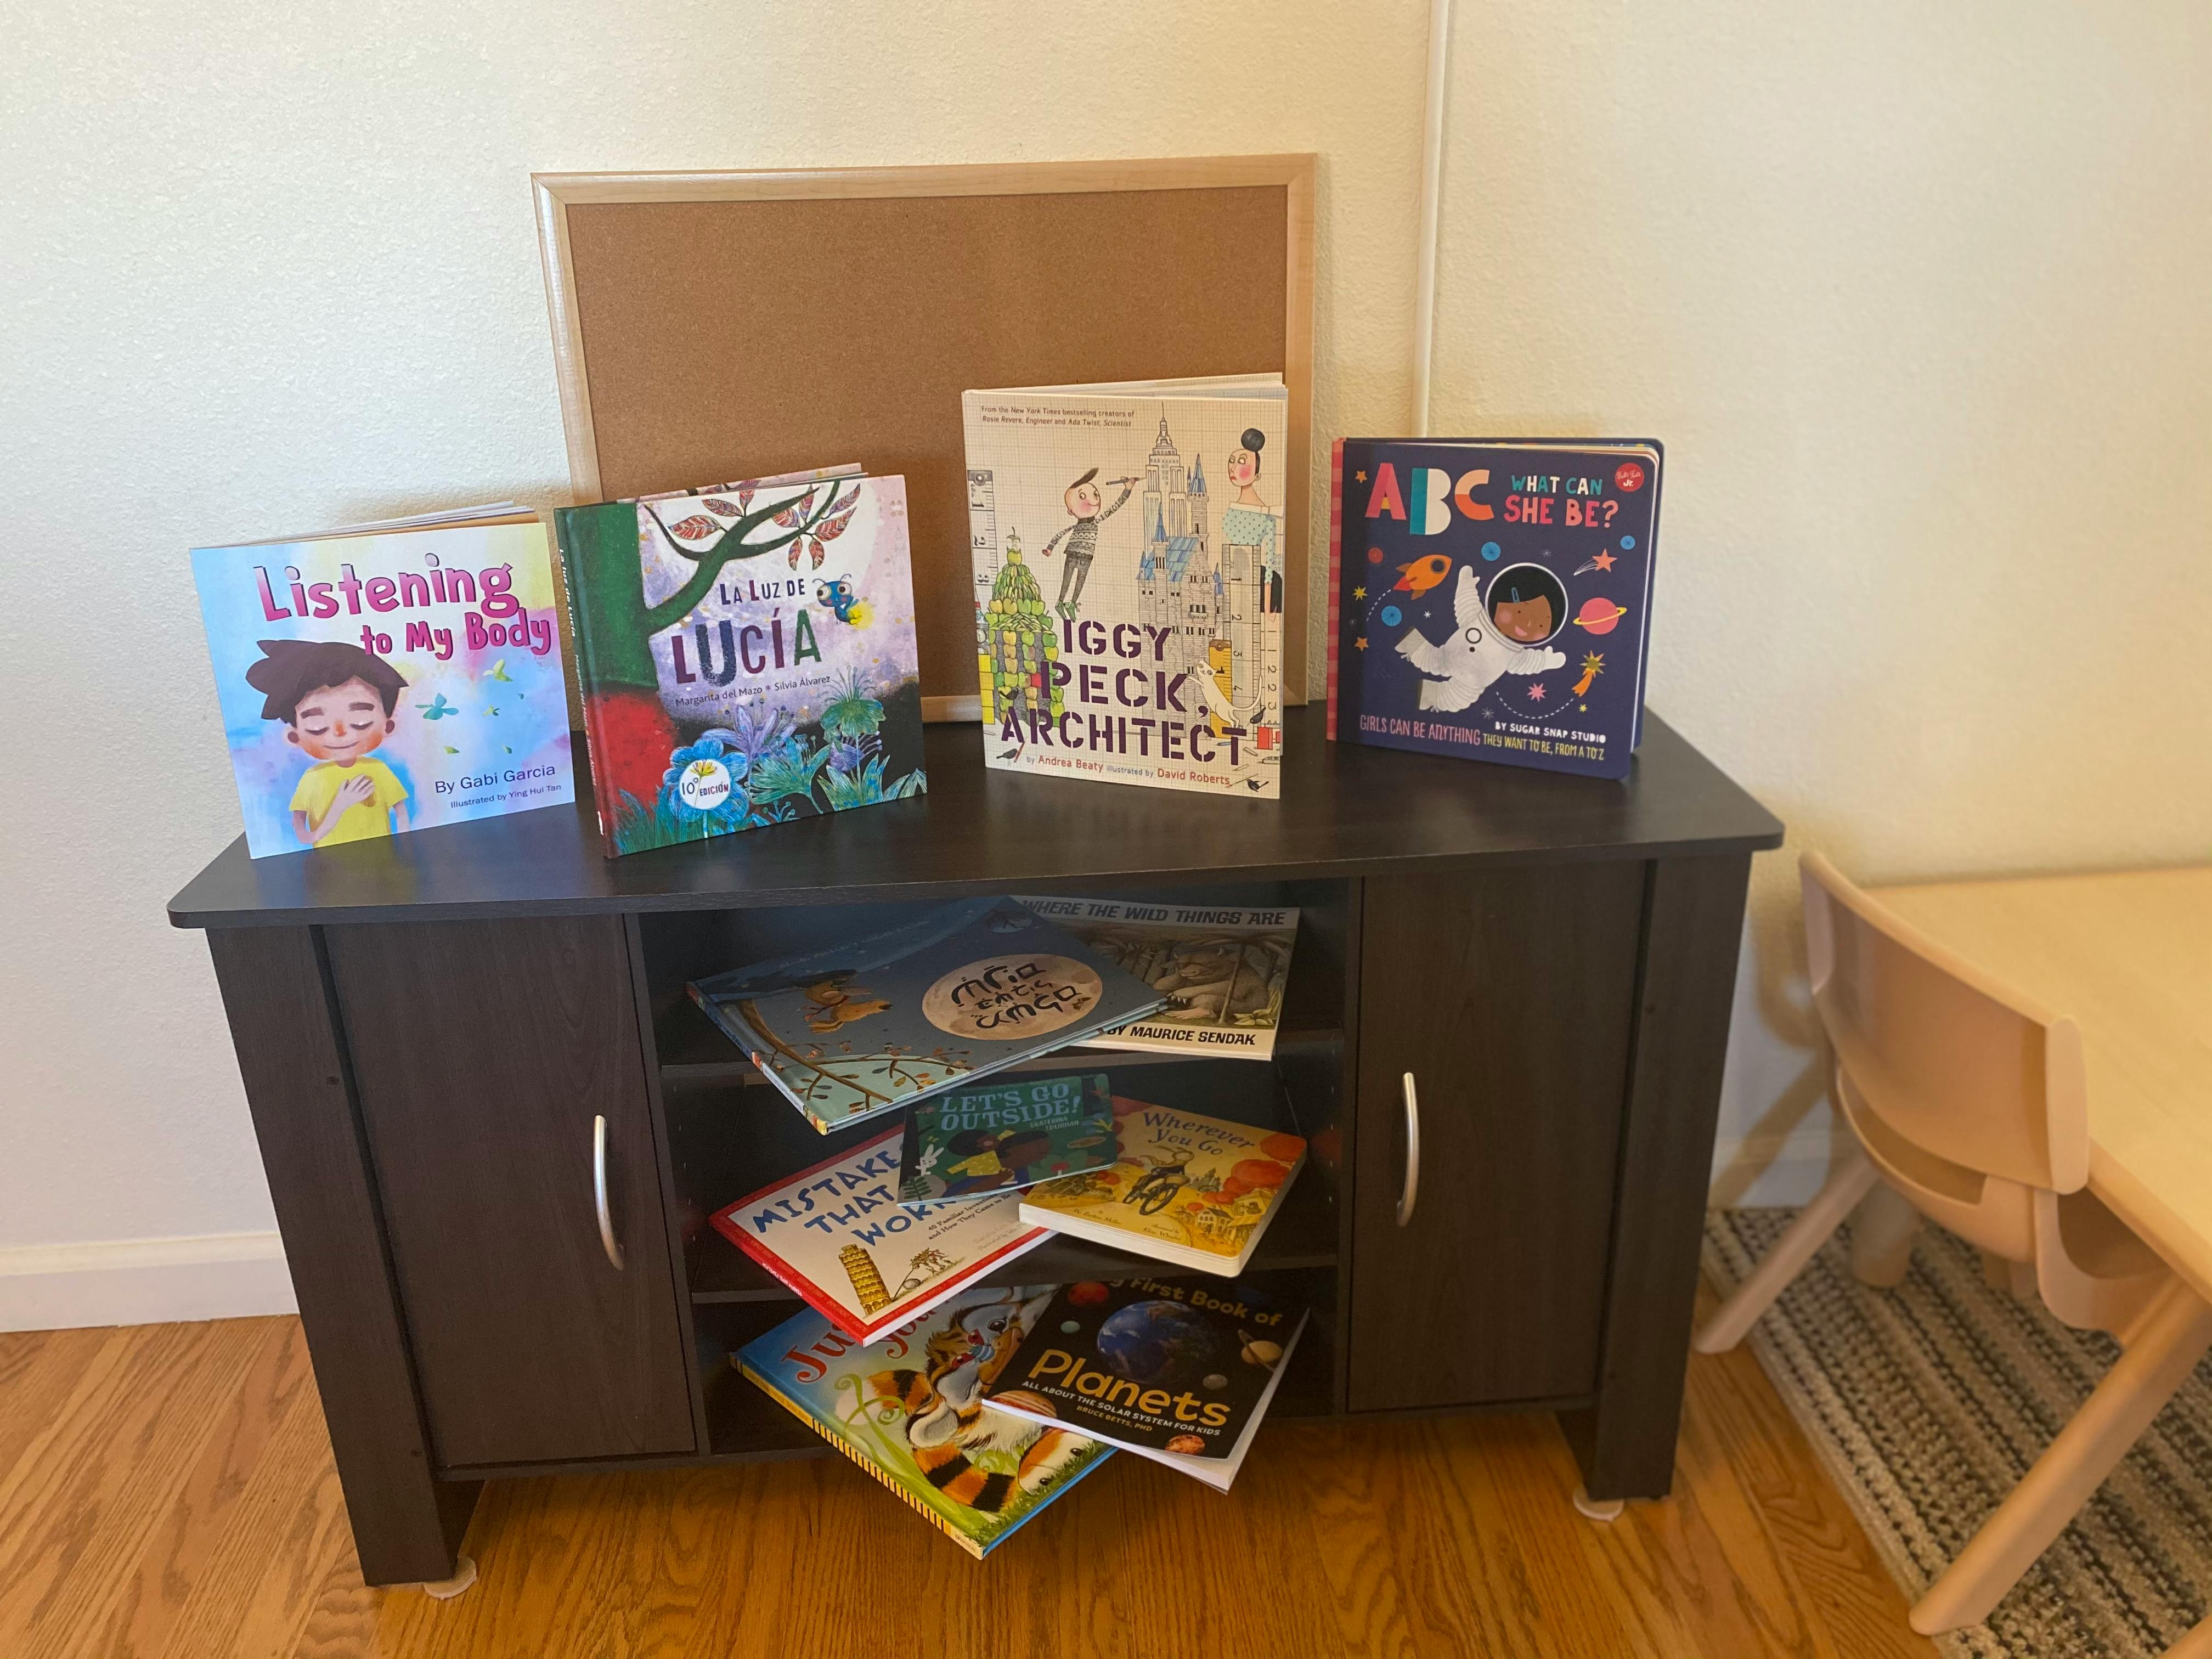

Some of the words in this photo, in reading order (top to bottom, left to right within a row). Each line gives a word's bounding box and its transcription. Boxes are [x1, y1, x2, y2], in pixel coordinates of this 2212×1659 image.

[1026, 417, 1052, 425] Engineer
[1062, 409, 1097, 417] bestselling
[1510, 475, 1560, 493] WHAT
[1566, 477, 1603, 495] CAN
[1623, 479, 1634, 487] Jr.
[1365, 462, 1495, 535] ABC
[1504, 494, 1554, 524] SHE
[1566, 499, 1619, 528] BE?
[253, 552, 520, 622] Listening
[787, 578, 805, 596] DE
[360, 625, 392, 656] to
[405, 620, 454, 661] My
[464, 607, 551, 656] Body
[672, 607, 821, 687] LUCÍA
[1064, 619, 1172, 661] IGGY
[676, 694, 719, 707] Margarita
[722, 690, 736, 699] del
[739, 687, 763, 697] Mazo
[774, 680, 797, 691] Silvia
[799, 676, 831, 687] Álvarez
[1042, 661, 1209, 718] PECK,
[1001, 707, 1247, 766] ARCHITECT
[1360, 715, 1387, 733] GIRLS
[1390, 720, 1410, 736] CAN
[1414, 722, 1426, 738] BE
[1495, 721, 1506, 730] BY
[1510, 723, 1540, 735] SUGAR
[1543, 728, 1568, 738] SNAP
[1571, 731, 1606, 743] STUDIO
[1482, 733, 1502, 747] THEY
[1504, 736, 1528, 751] WANT
[1529, 740, 1539, 752] TO
[1542, 742, 1553, 755] BE,
[1555, 743, 1577, 757] FROM
[1579, 747, 1584, 757] A
[1586, 747, 1597, 759] TO
[1598, 748, 1604, 760] Z
[435, 781, 455, 794] By
[460, 772, 498, 789] Gabi
[504, 765, 555, 782] Garcia
[1026, 755, 1035, 765] by
[1038, 755, 1072, 768] Andrea
[1076, 759, 1103, 772] Beaty
[1107, 765, 1143, 776] illustrated
[1145, 769, 1154, 778] by
[1158, 769, 1186, 780] David
[1189, 772, 1230, 785] Roberts
[450, 794, 494, 808] Illustrated
[509, 789, 528, 798] Ying
[530, 787, 544, 795] Hui
[699, 781, 729, 797] EDICIÓN
[1023, 900, 1082, 915] WHERE
[1088, 904, 1119, 918] THE
[1124, 906, 1169, 921] WILD
[1175, 910, 1242, 925] THINGS
[1247, 911, 1286, 926] ARE
[1107, 1025, 1127, 1035] BY
[1130, 1026, 1195, 1041] MAURICE
[1198, 1031, 1256, 1046] SENDAK
[939, 1091, 1022, 1113] LET'S
[1031, 1084, 1069, 1102] GO
[941, 1096, 1080, 1131] OUTSIDE!
[1143, 1112, 1255, 1148] Wherever
[1198, 1140, 1223, 1155] Go
[753, 1144, 903, 1233] MISTAKE
[804, 1184, 895, 1233] THAT
[928, 1223, 938, 1232] 40
[938, 1210, 964, 1226] Familiar
[929, 1231, 941, 1240] and
[941, 1221, 958, 1232] How
[957, 1212, 975, 1226] They
[975, 1203, 994, 1214] Came
[1130, 1278, 1185, 1300] First
[1190, 1290, 1248, 1318] Book
[1255, 1312, 1283, 1326] of
[1028, 1349, 1231, 1426] Planets
[1022, 1380, 1039, 1391] ALL
[1041, 1386, 1075, 1400] ABOUT
[1077, 1395, 1096, 1407] THE
[1097, 1402, 1131, 1418] SOLAR
[1132, 1412, 1173, 1427] SYSTEM
[1174, 1422, 1194, 1432] FOR
[1197, 1426, 1221, 1436] KIDS
[1076, 1405, 1103, 1419] BRUCE
[1105, 1414, 1133, 1428] BETTS,
[1134, 1422, 1152, 1432] PHD
